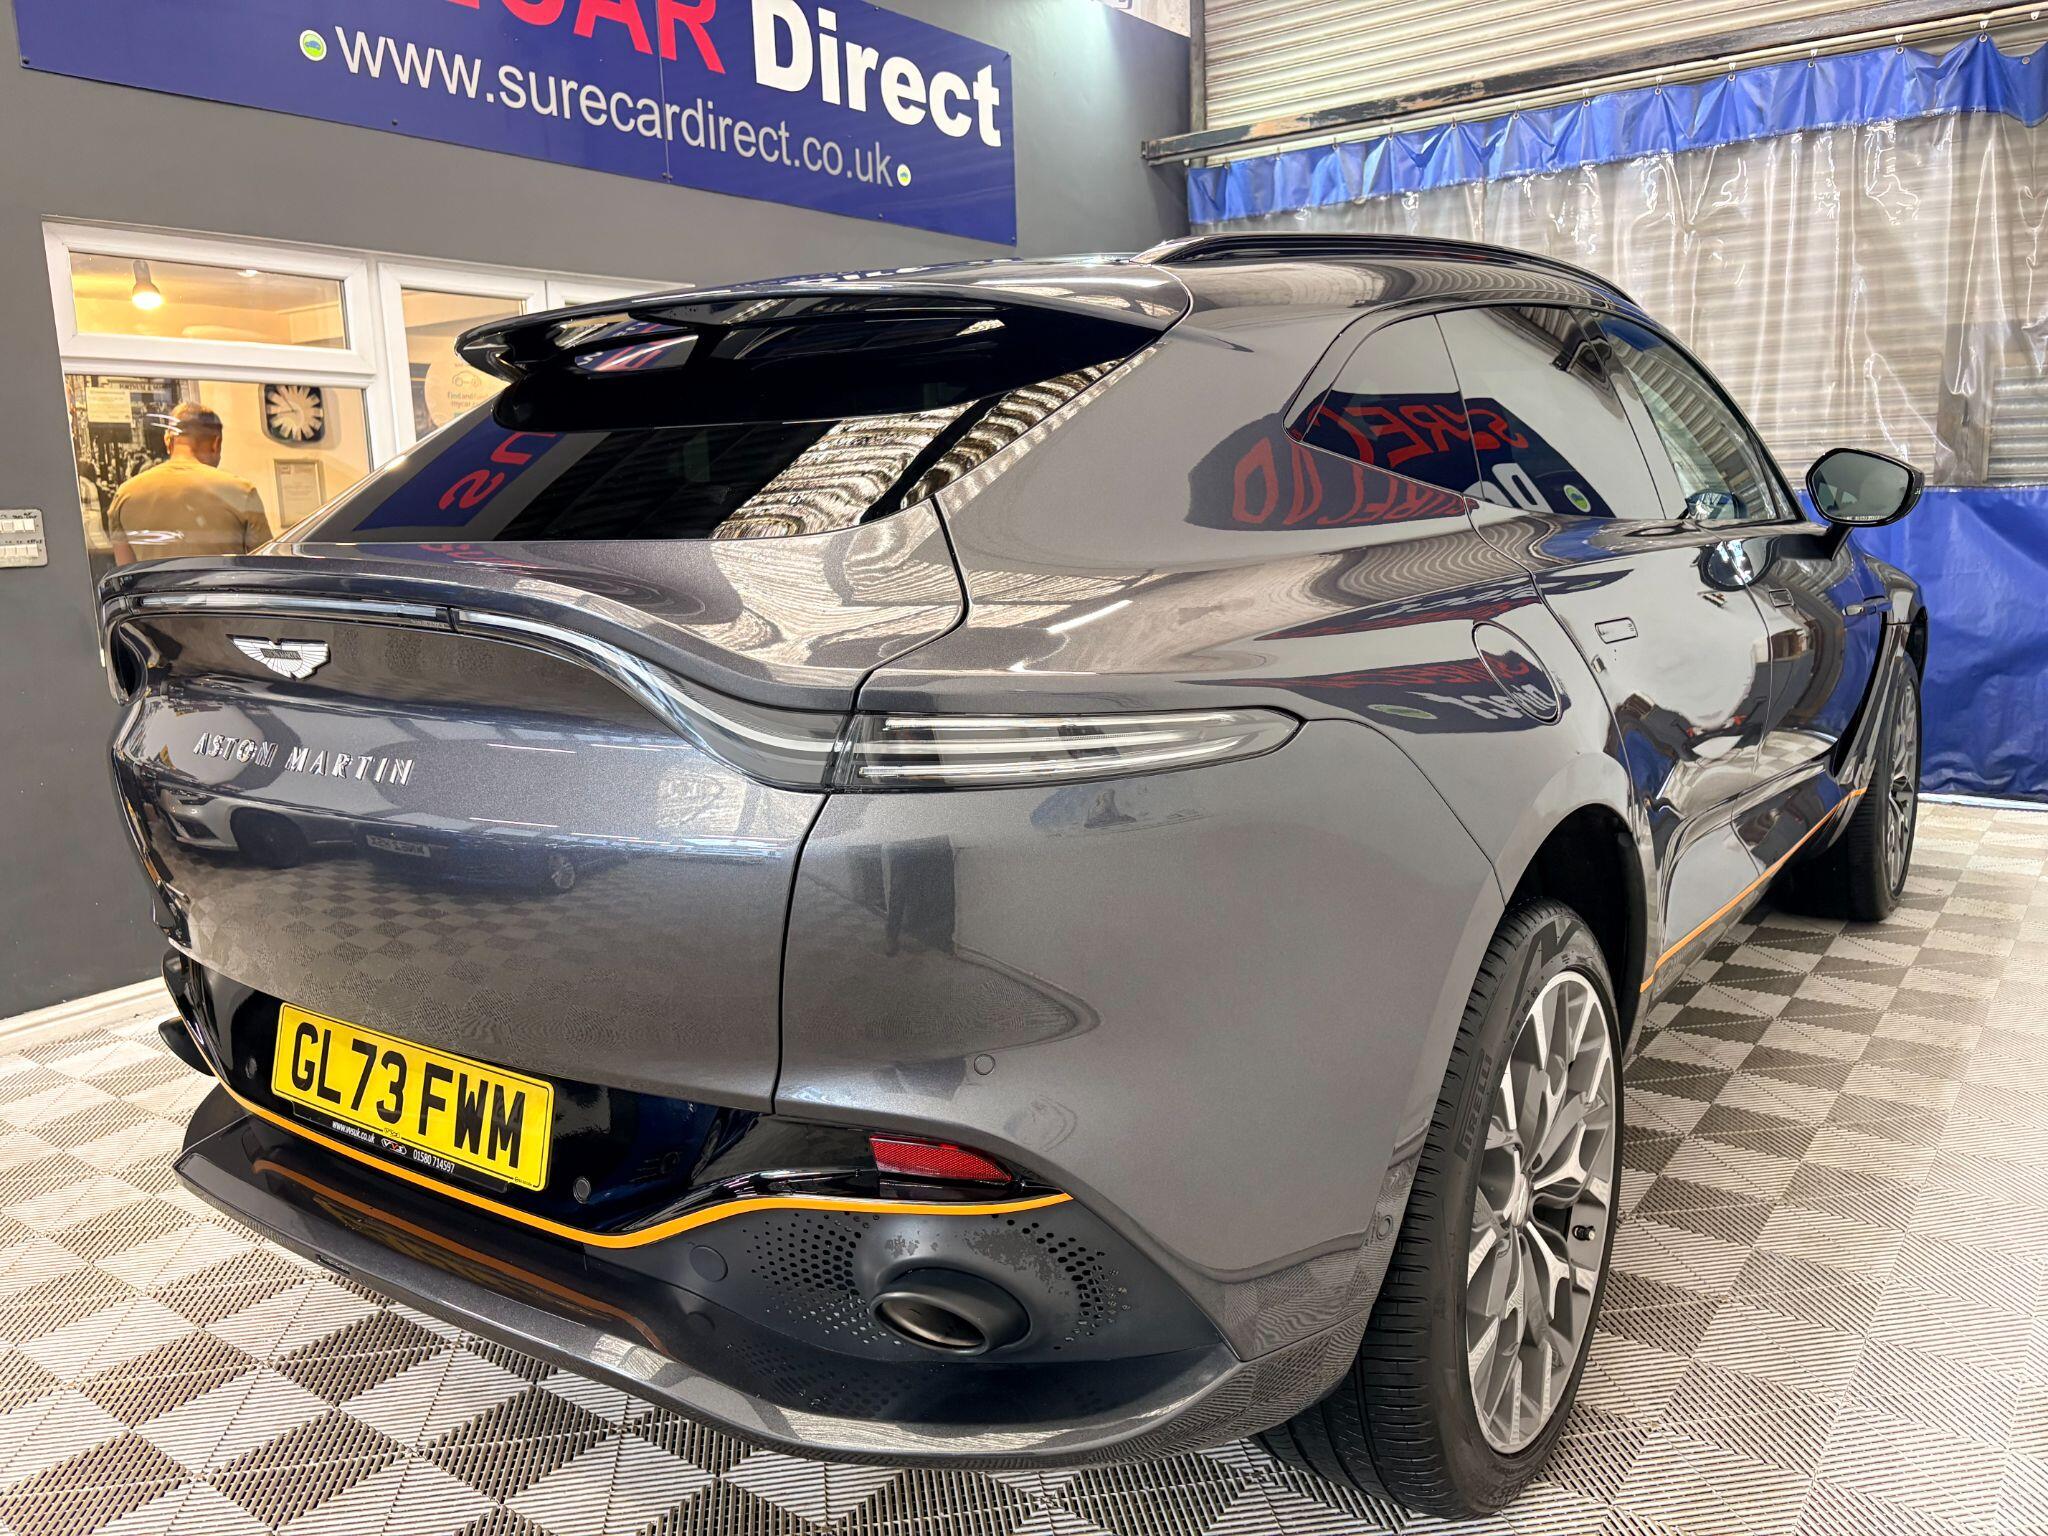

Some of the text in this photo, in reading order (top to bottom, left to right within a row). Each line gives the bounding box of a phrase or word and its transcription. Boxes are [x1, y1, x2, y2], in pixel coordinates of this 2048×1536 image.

[334, 25, 894, 188] www.surecardirect.co.uk
[751, 0, 1002, 148] Direct
[193, 732, 415, 787] ASTON MARTIN
[291, 1021, 526, 1169] GL73 FWM
[413, 1149, 432, 1166] 01580
[432, 1155, 456, 1173] 714597
